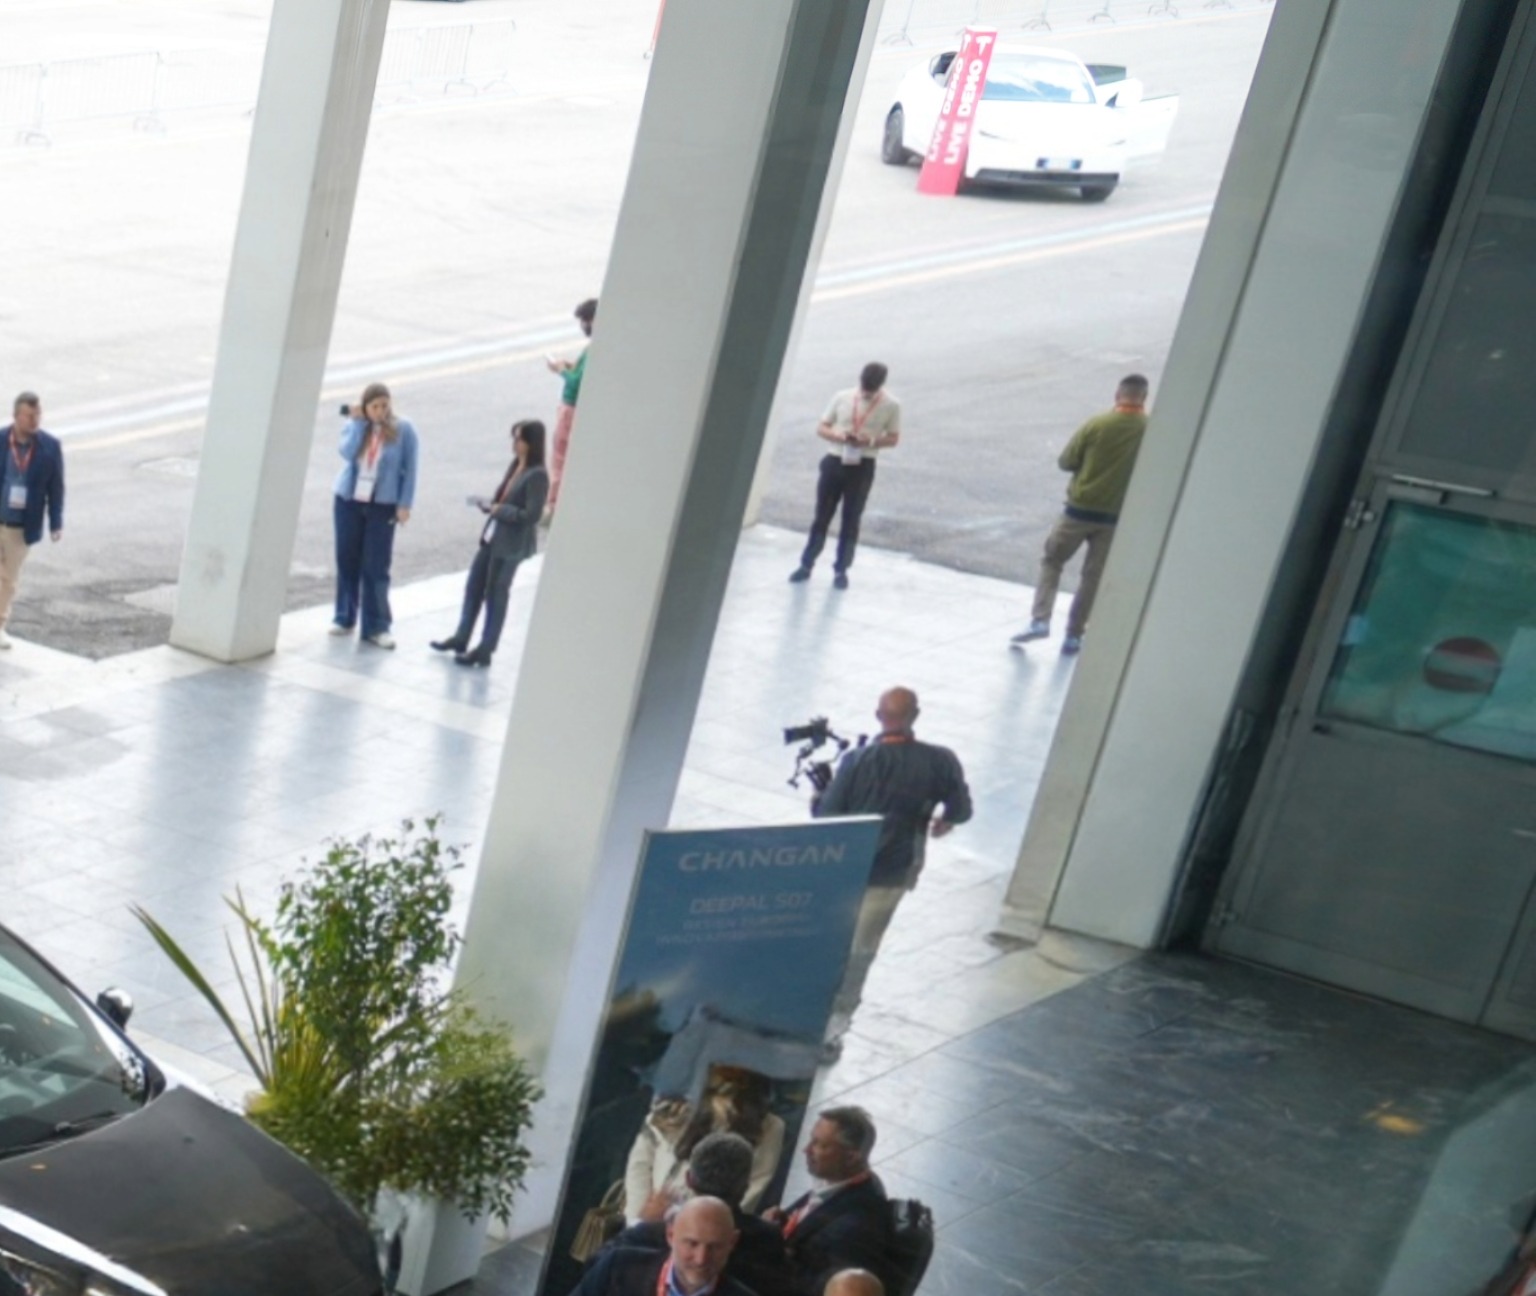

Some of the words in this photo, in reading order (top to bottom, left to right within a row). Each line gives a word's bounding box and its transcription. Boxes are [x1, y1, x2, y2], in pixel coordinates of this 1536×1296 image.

[943, 119, 967, 165] LIVE
[957, 59, 983, 117] DEMO
[678, 843, 847, 871] CHANGAN
[689, 895, 768, 914] DEEPAL
